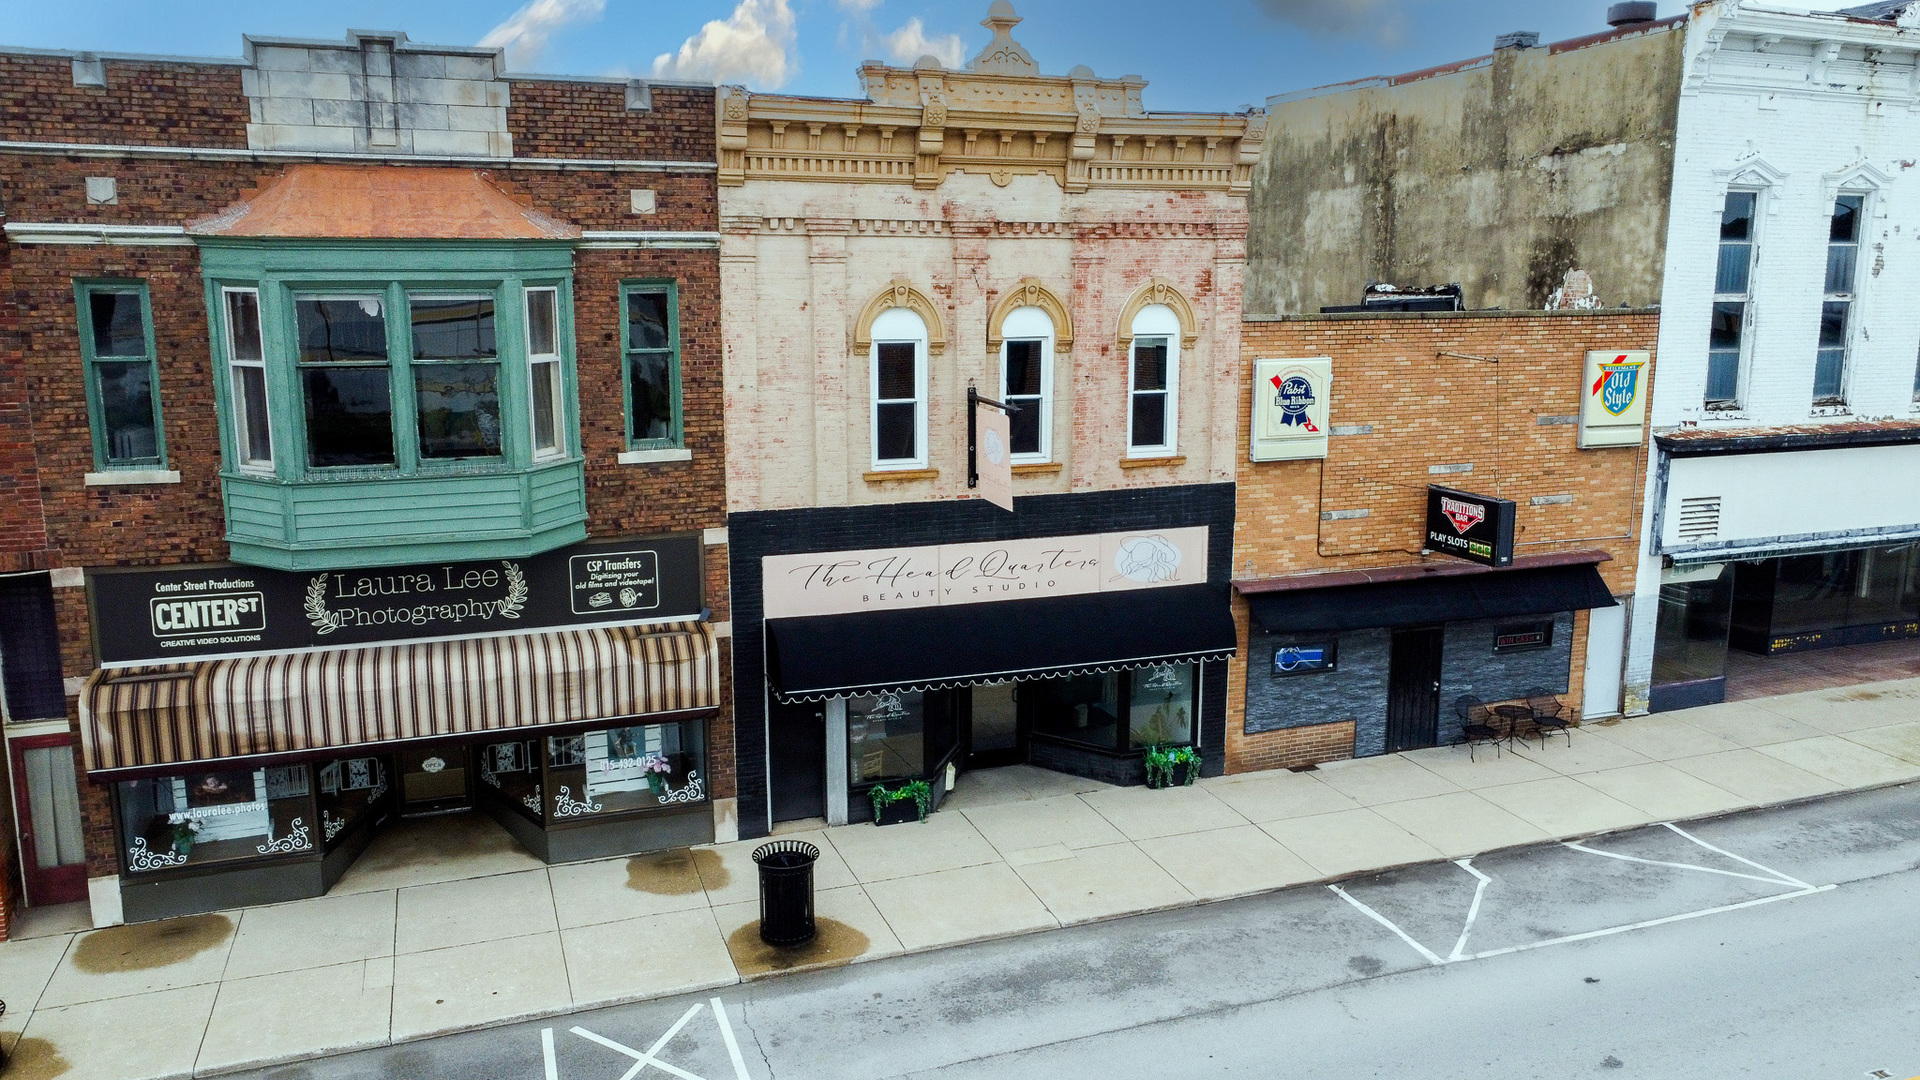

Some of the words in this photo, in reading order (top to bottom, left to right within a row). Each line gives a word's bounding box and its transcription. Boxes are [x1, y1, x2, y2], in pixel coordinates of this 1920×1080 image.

[1282, 381, 1307, 395] Pabst
[1611, 372, 1631, 389] Old
[1275, 396, 1291, 406] Blue
[1290, 395, 1315, 405] Ribbon
[1605, 387, 1632, 410] Style
[1441, 498, 1484, 520] TRADITIONS
[1455, 513, 1468, 522] BAR
[1430, 531, 1447, 543] PLAY
[1447, 535, 1469, 549] SLOTS
[586, 560, 602, 572] CSP
[603, 557, 641, 571] Transfers
[788, 560, 861, 590] The
[864, 556, 974, 588] Head
[973, 548, 1099, 580] Quarters
[333, 573, 435, 598] Laura
[442, 566, 499, 591] Lee
[575, 581, 587, 590] old
[587, 580, 603, 588] films
[604, 579, 618, 587] and
[619, 577, 655, 586] videotape!
[590, 571, 622, 581] Digitizing
[623, 571, 639, 579] your
[155, 582, 182, 593] Center
[183, 580, 207, 591] Street
[208, 578, 255, 589] Productions
[862, 587, 952, 602] BEAUTY
[972, 579, 1056, 594] STUDIO
[338, 598, 500, 626] Photography
[160, 638, 195, 648] CREATIVE
[196, 636, 219, 645] VIDEO
[220, 634, 261, 643] SOLUTIONS
[1515, 634, 1534, 643] CASH
[600, 755, 657, 770] 815-432-0125
[168, 802, 265, 819] www.lauralee.photos
